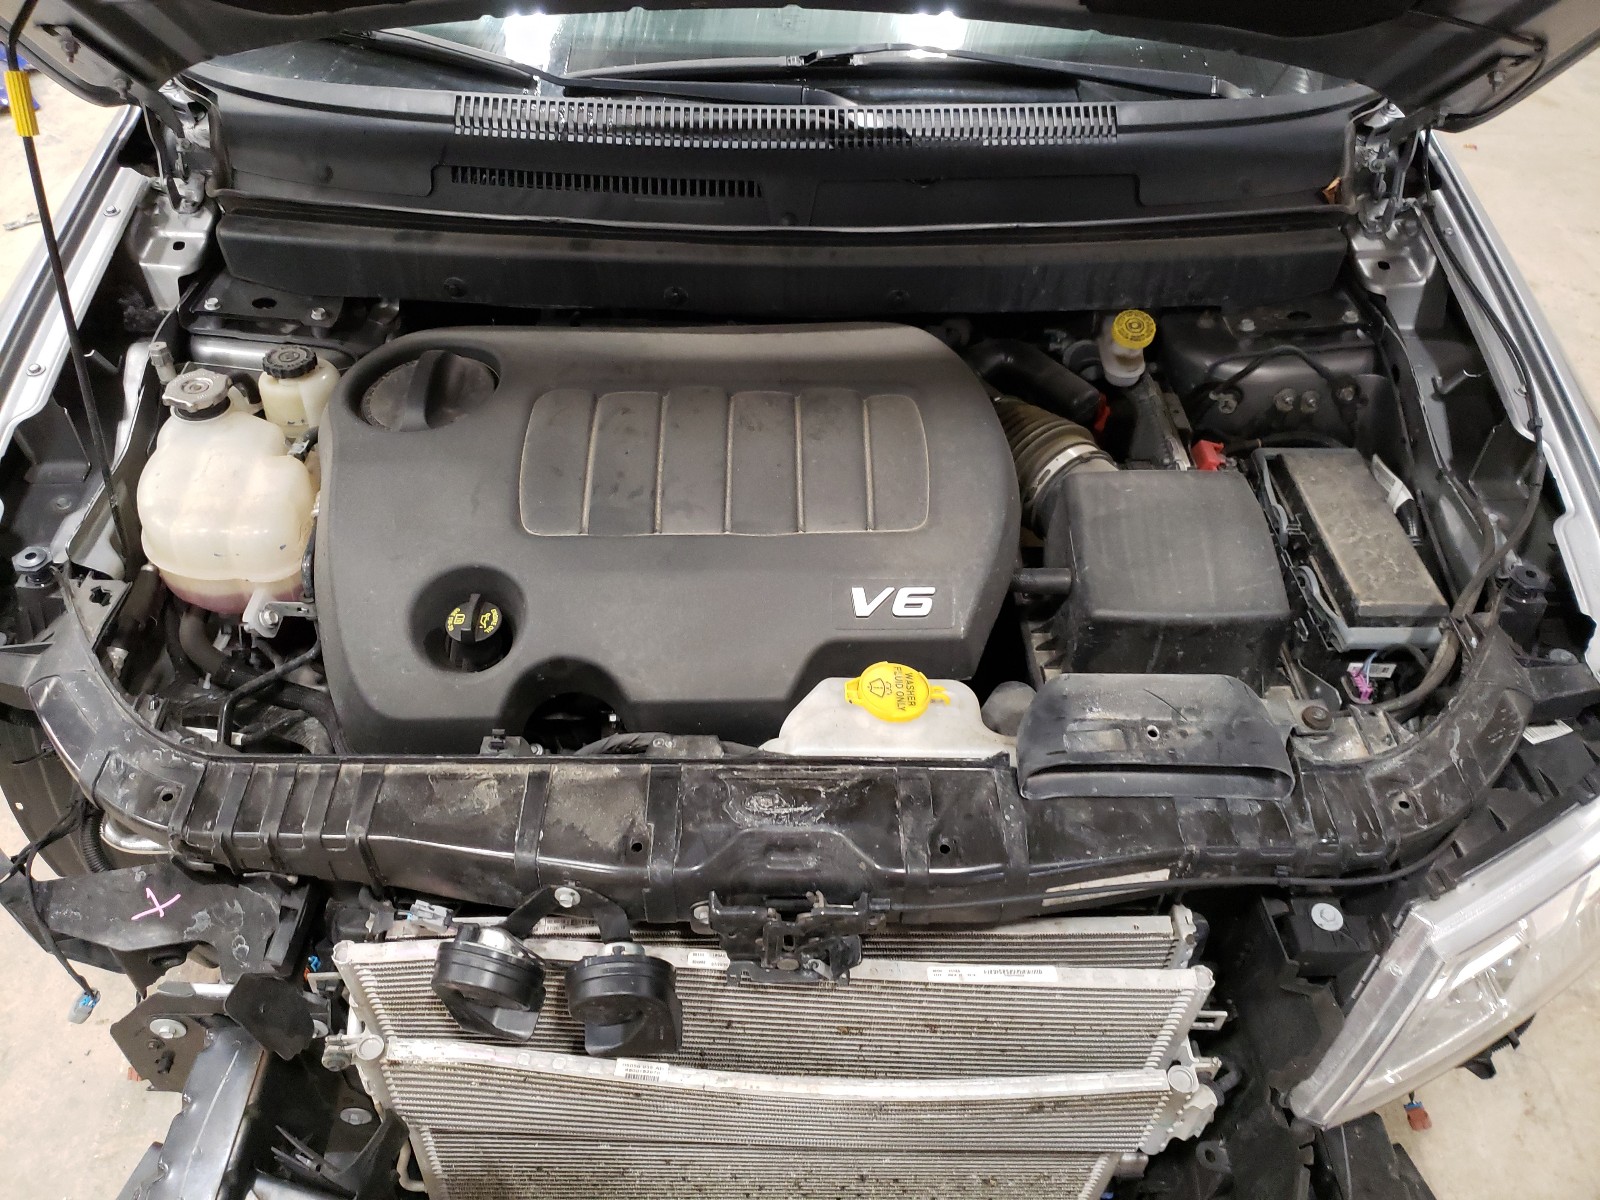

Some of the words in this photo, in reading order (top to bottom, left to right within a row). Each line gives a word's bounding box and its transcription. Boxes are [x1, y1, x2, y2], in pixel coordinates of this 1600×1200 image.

[850, 586, 936, 618] V6
[483, 625, 494, 633] OIL
[894, 666, 904, 691] FLUID
[905, 672, 916, 707] WASHER
[895, 691, 906, 711] ONLY
